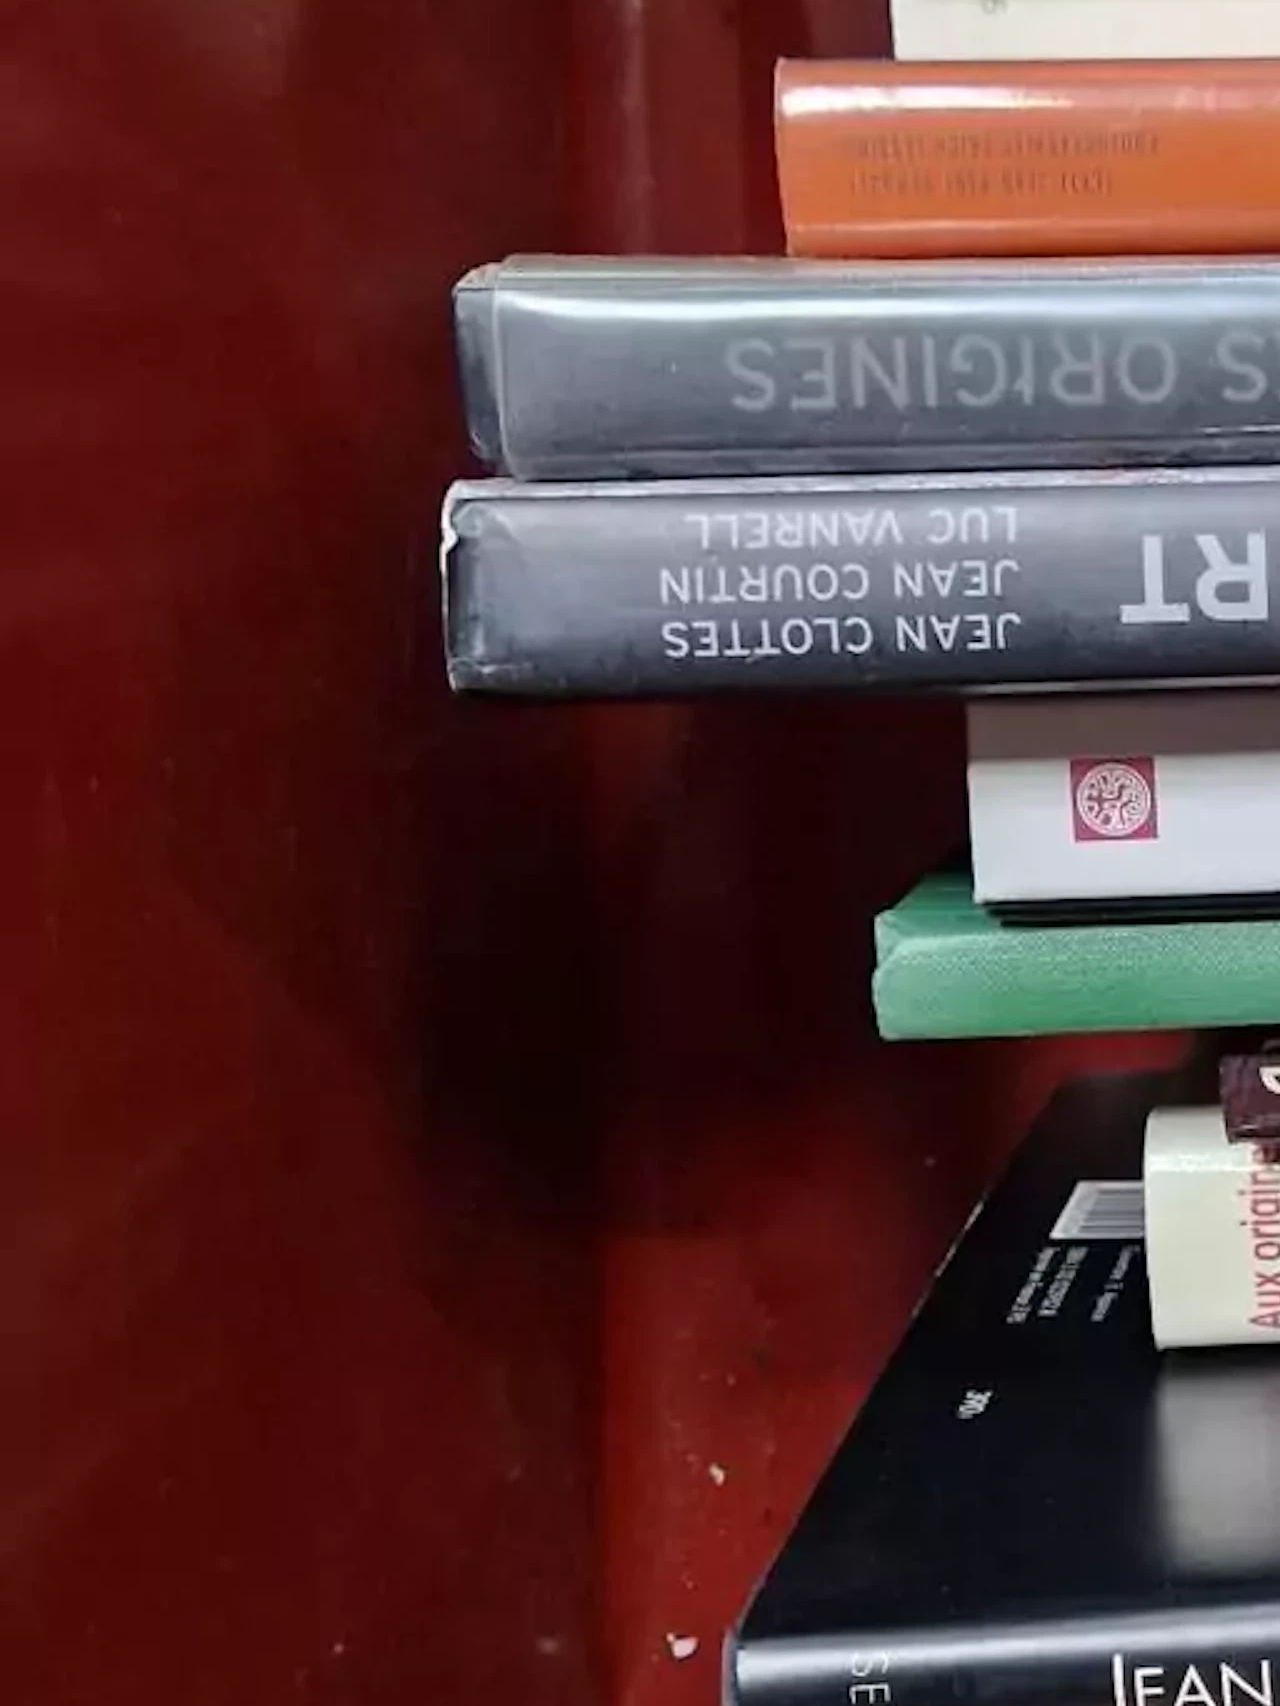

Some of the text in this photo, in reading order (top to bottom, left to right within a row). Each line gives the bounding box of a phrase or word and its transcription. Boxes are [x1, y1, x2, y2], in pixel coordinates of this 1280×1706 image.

[722, 331, 1180, 413] ORIGINES
[685, 507, 1020, 551] LUC VANRELL
[657, 559, 1020, 605] JEAN COURTIN
[660, 613, 1021, 659] JEAN CLOTTES
